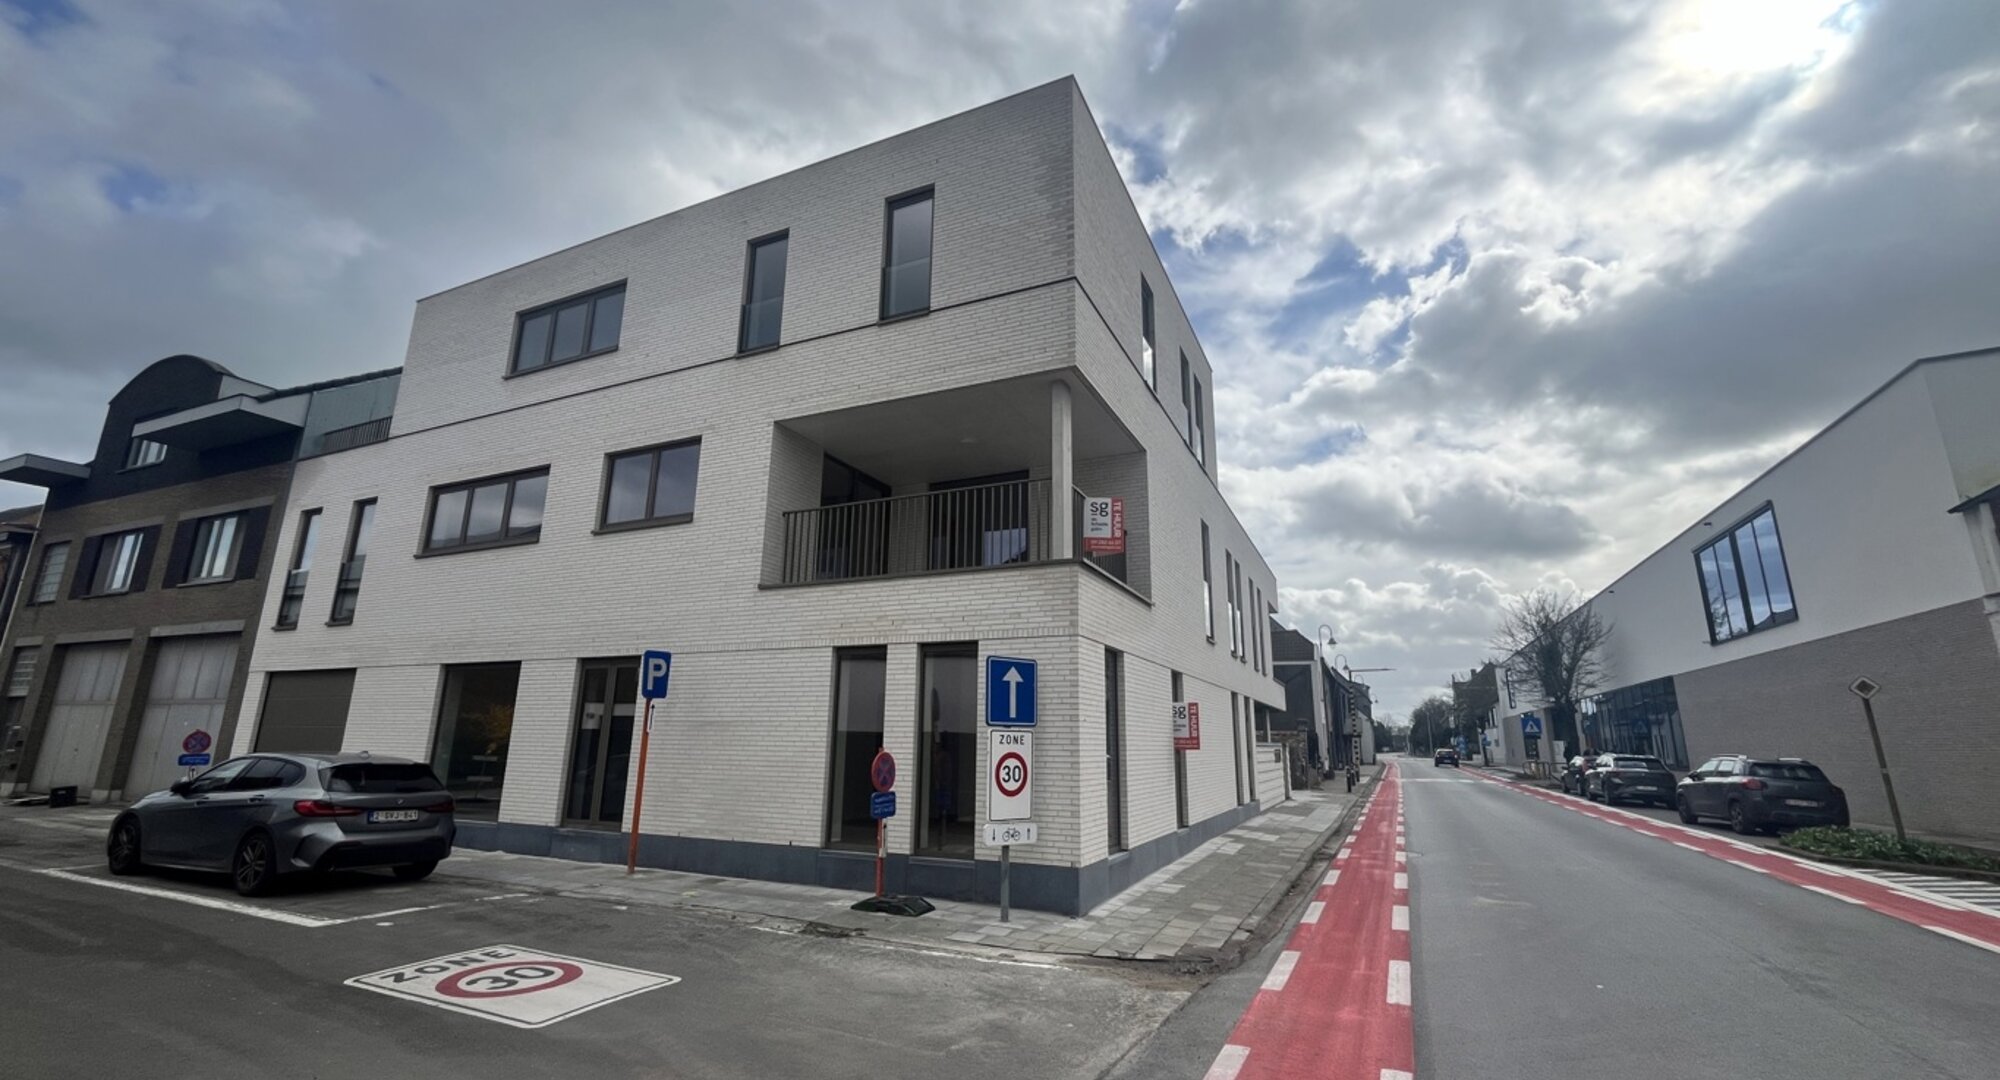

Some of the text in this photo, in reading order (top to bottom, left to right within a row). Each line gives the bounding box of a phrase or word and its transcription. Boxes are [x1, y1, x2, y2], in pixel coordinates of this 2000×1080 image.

[1090, 501, 1109, 517] sg
[1113, 502, 1122, 538] TE HUUR
[647, 658, 667, 690] P
[999, 734, 1025, 745] ZONE
[1002, 765, 1021, 782] 30
[380, 949, 516, 984] ZONE
[465, 966, 555, 991] 30
